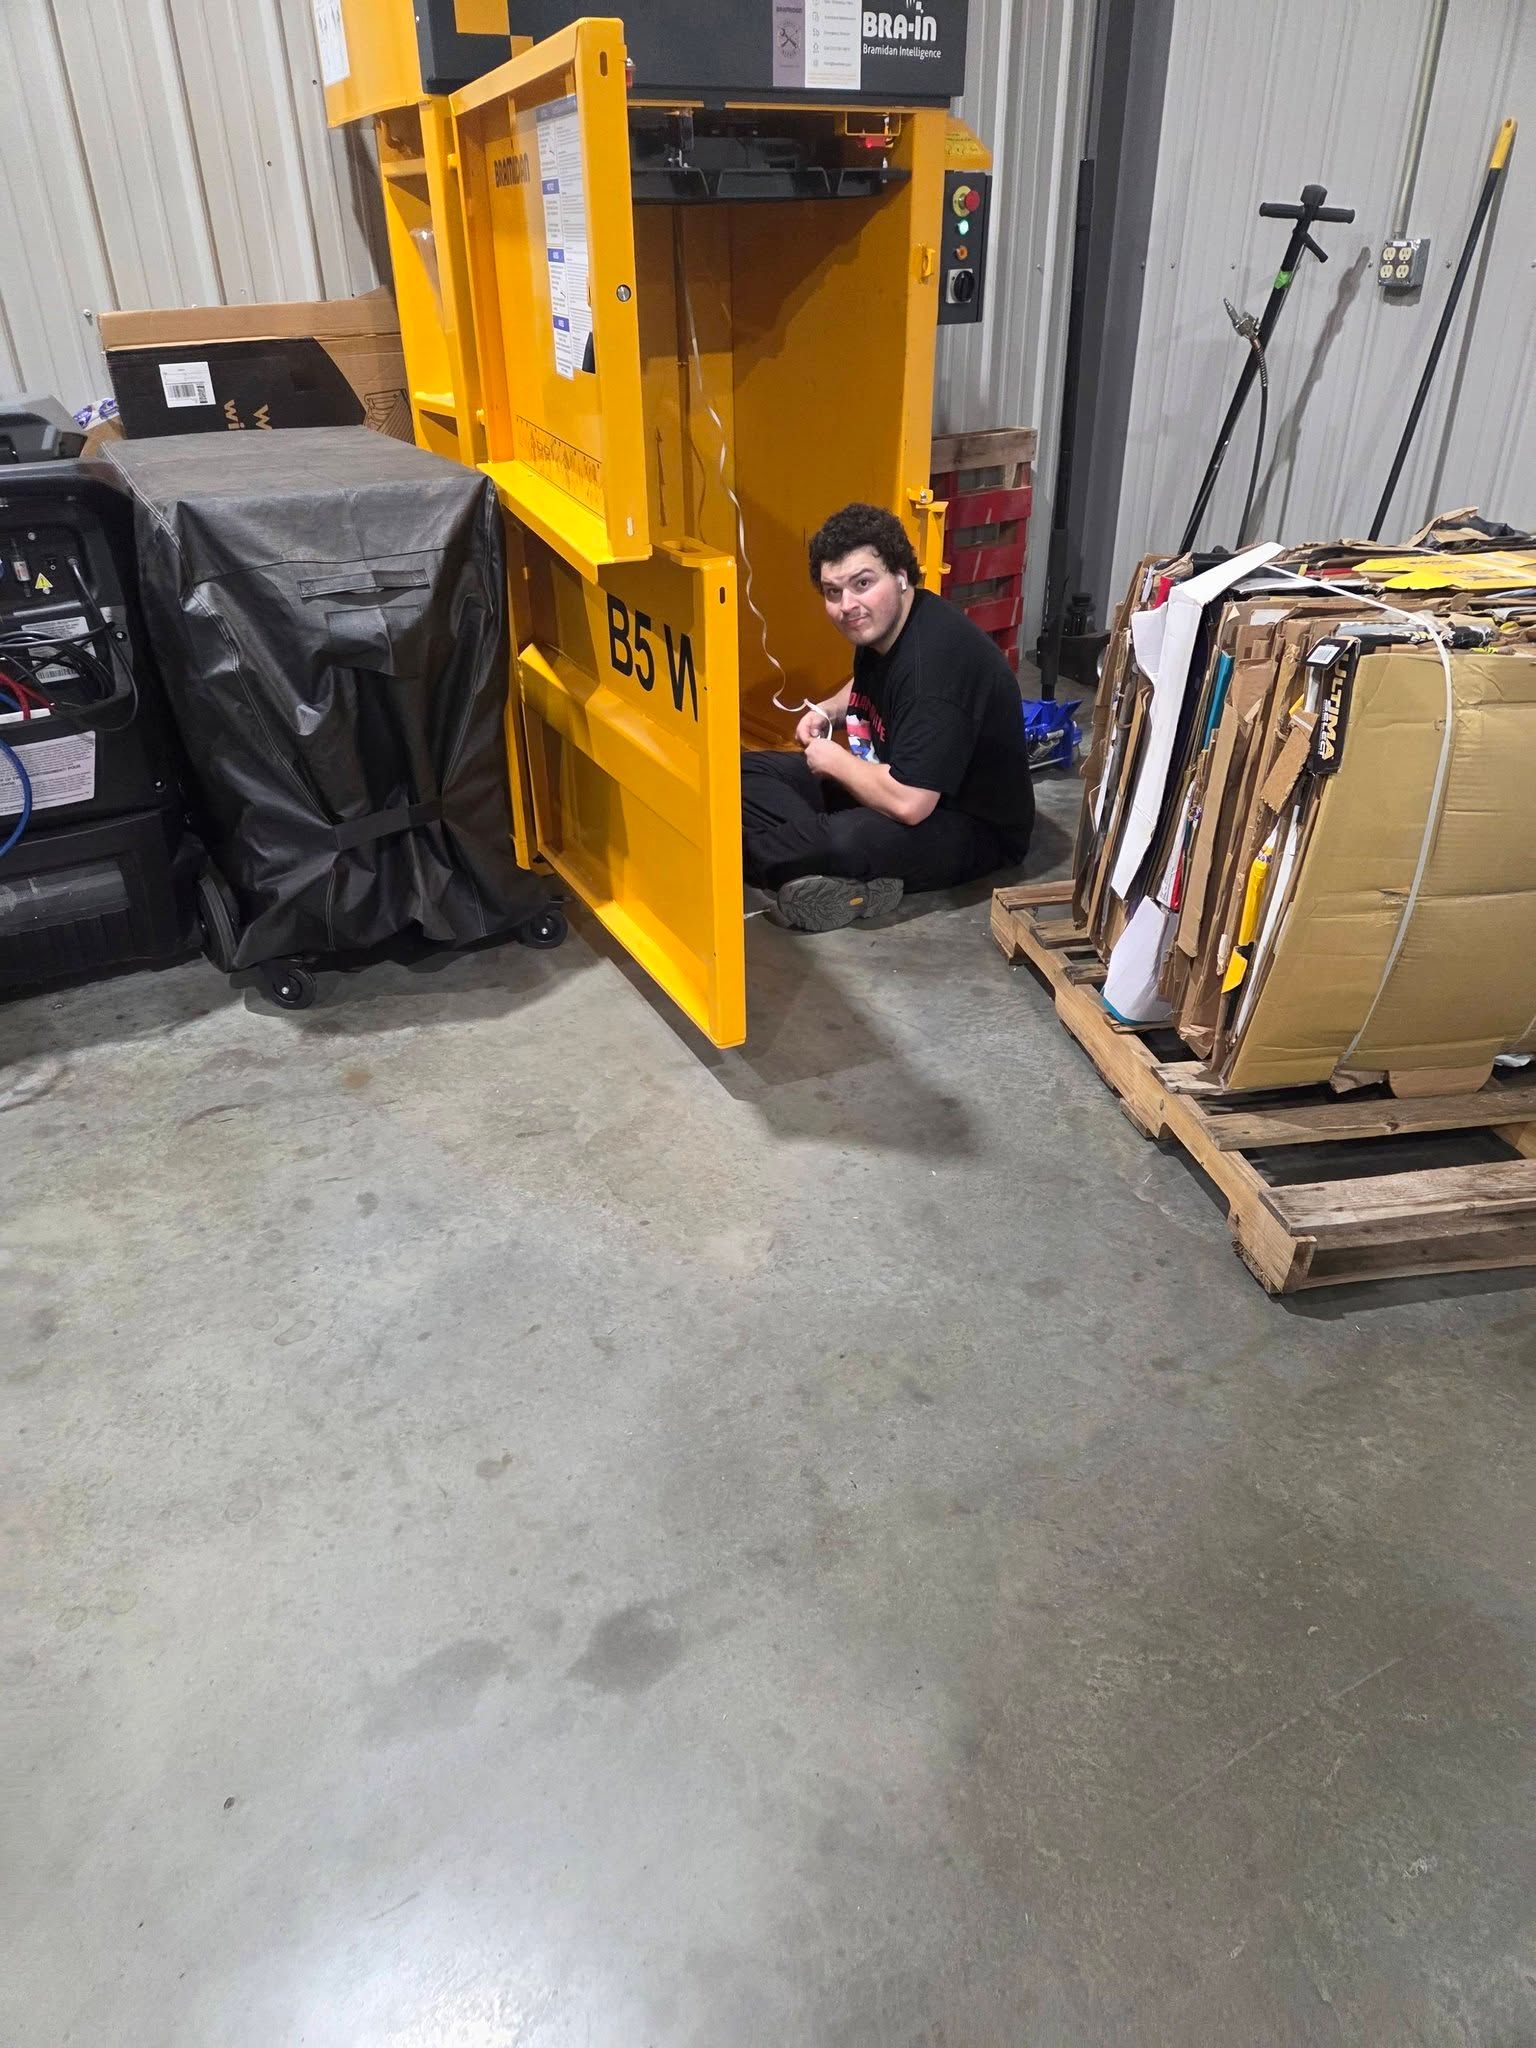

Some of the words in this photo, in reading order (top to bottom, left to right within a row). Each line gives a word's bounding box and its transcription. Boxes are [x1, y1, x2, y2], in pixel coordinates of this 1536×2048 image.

[863, 43, 898, 56] Bramidan
[899, 46, 942, 60] Intelligence
[1322, 653, 1349, 760] ULTIMA
